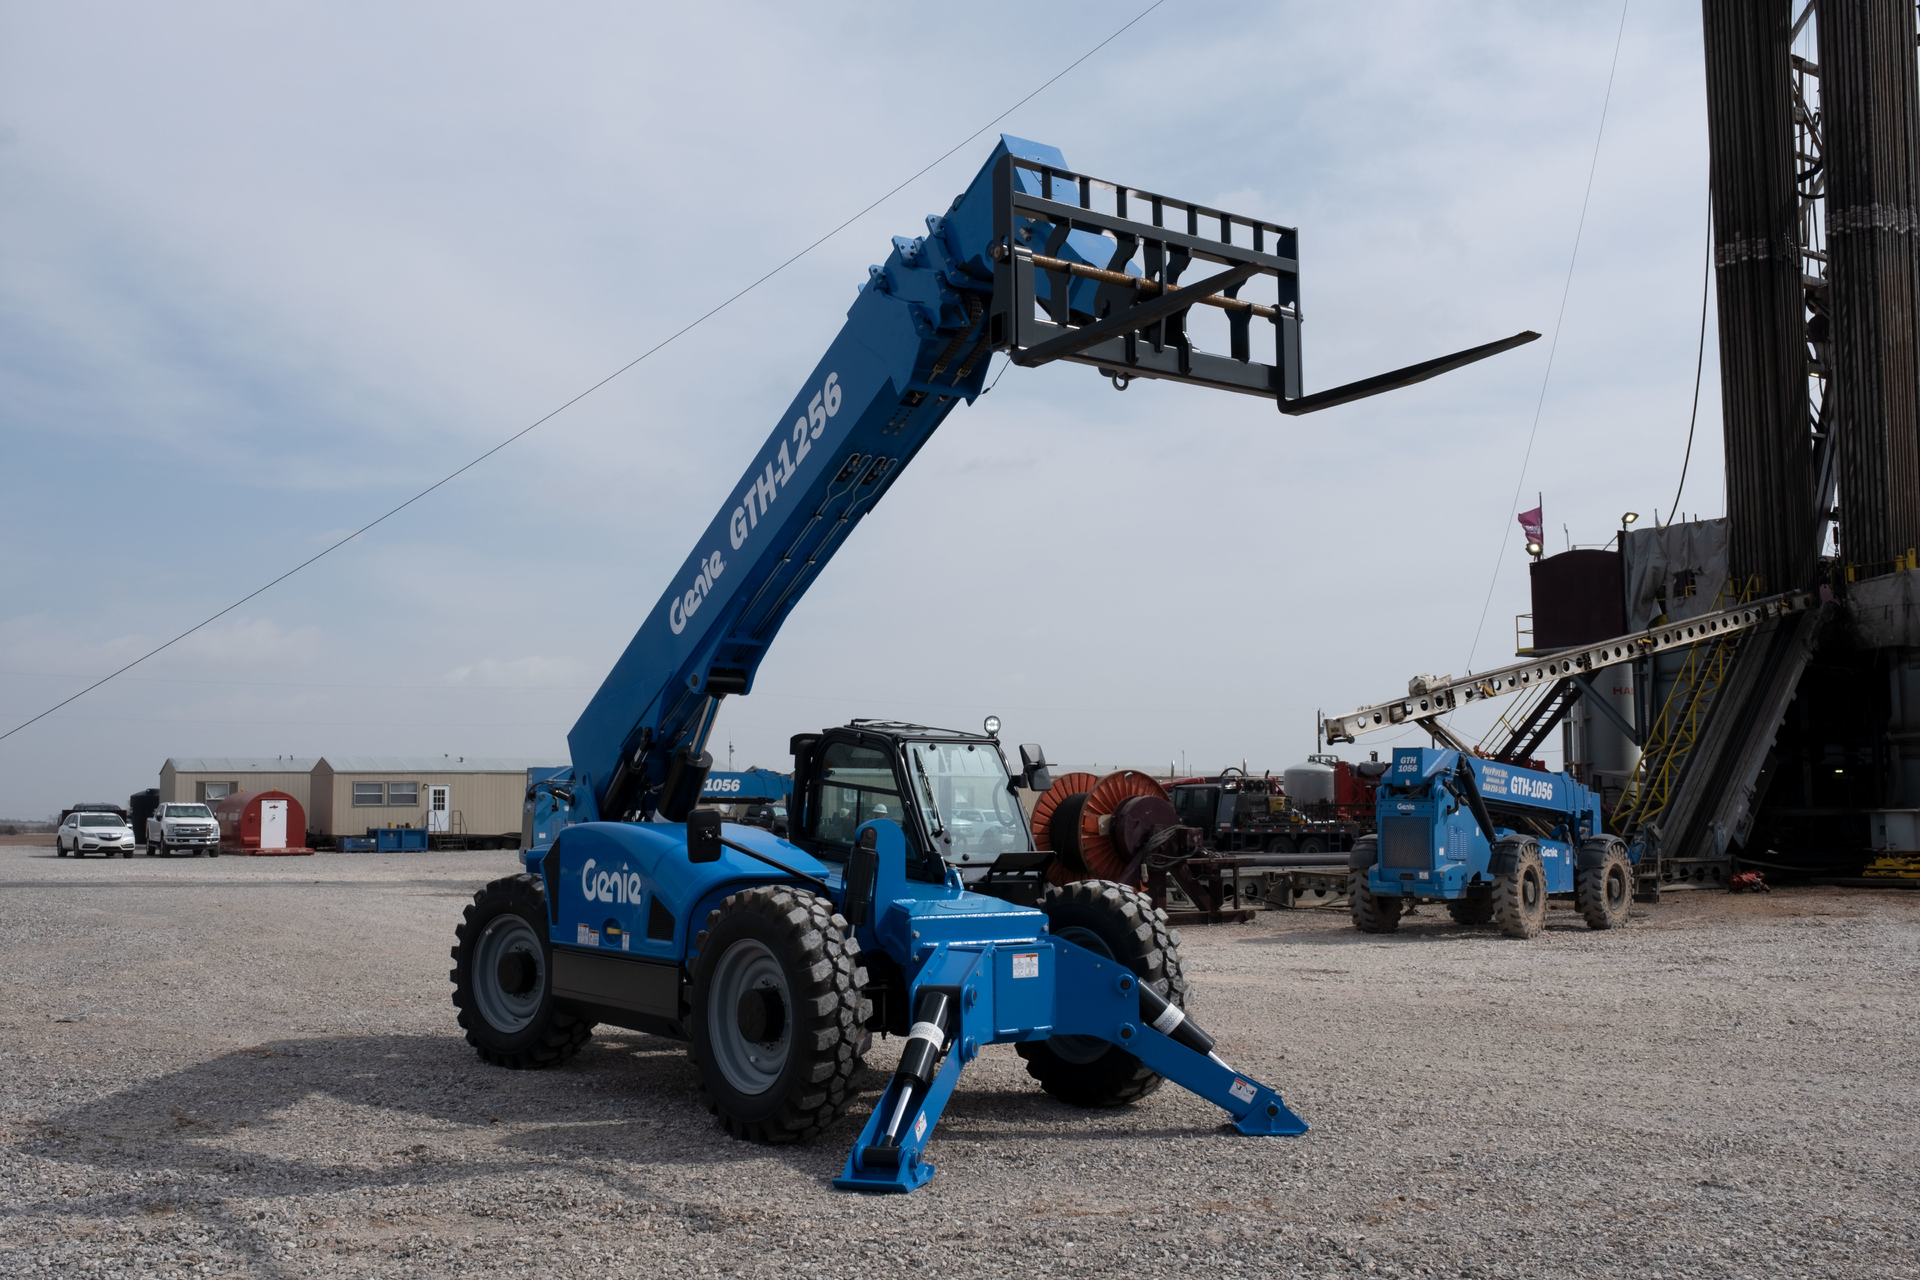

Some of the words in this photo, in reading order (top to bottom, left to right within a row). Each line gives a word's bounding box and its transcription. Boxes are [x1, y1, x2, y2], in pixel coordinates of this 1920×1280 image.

[669, 550, 726, 635] Genie
[730, 371, 842, 550] GTH-1256
[1400, 756, 1417, 764] GTH
[1397, 764, 1418, 773] 1056
[703, 778, 741, 792] 1056
[1511, 775, 1553, 800] GTH-1056
[1396, 803, 1416, 811] Genie
[1541, 846, 1558, 858] Genie
[582, 858, 642, 905] Genie
